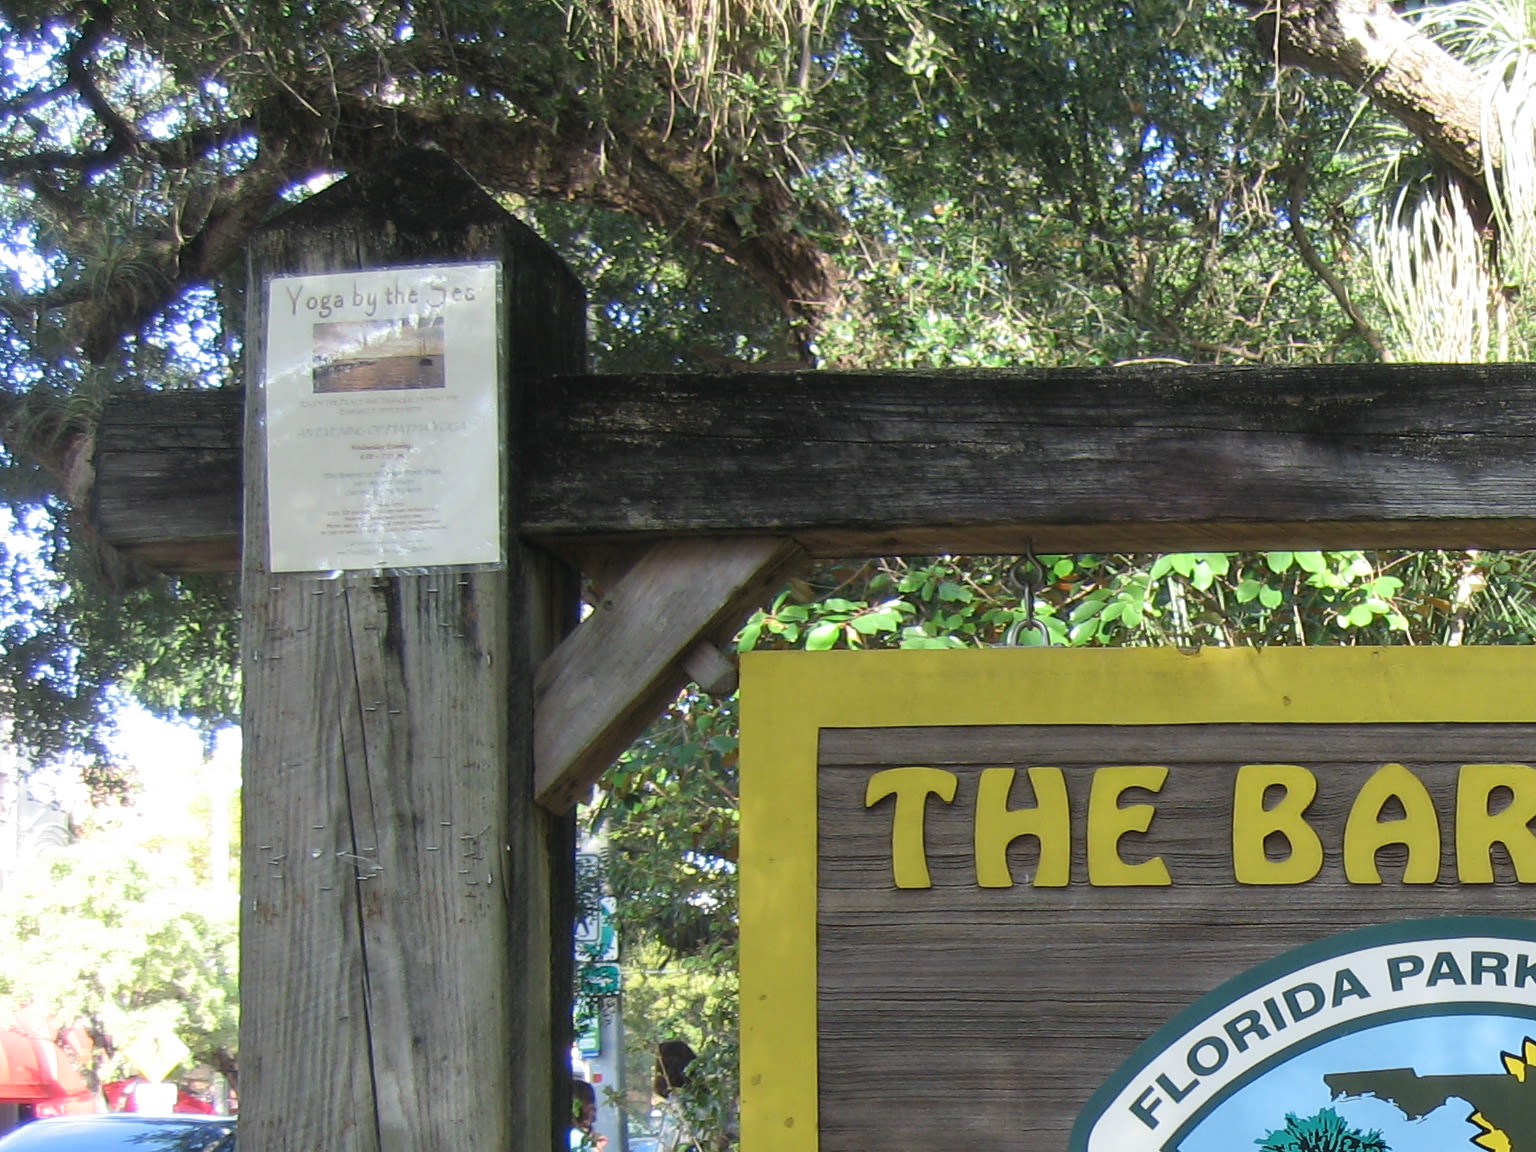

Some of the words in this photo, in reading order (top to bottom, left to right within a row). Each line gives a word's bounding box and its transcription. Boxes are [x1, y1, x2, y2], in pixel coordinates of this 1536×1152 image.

[286, 284, 344, 318] Yoga
[352, 280, 377, 316] by
[385, 276, 418, 305] the
[865, 766, 1172, 889] THE
[1129, 967, 1371, 1130] FLORIDA
